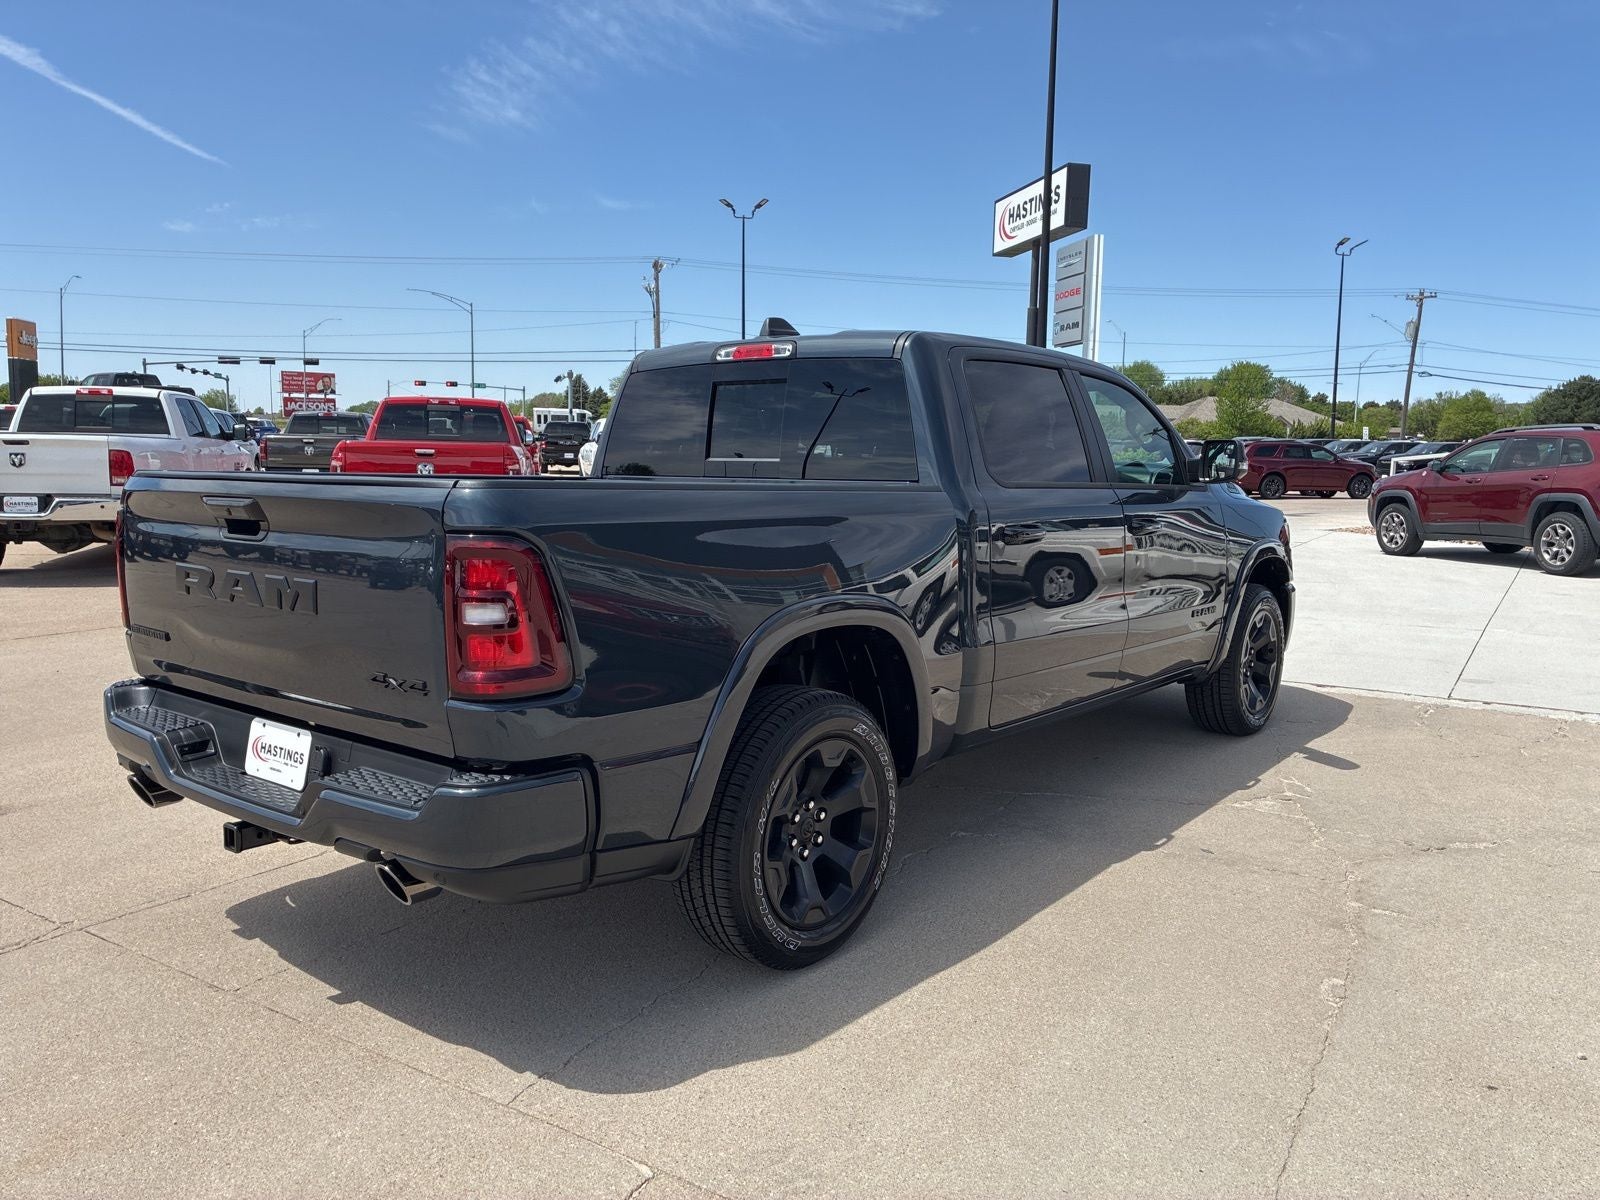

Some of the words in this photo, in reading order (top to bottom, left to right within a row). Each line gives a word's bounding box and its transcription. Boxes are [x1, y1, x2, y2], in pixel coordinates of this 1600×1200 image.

[1008, 184, 1060, 225] HASTINS
[1058, 251, 1082, 262] CHRYSLER
[1056, 287, 1081, 301] DODGE
[1060, 321, 1080, 332] RAM
[18, 330, 38, 349] Jeep
[176, 562, 318, 615] RAM
[1191, 605, 1216, 618] RAM
[260, 741, 304, 766] HASTINGS
[754, 851, 801, 951] DUELER
